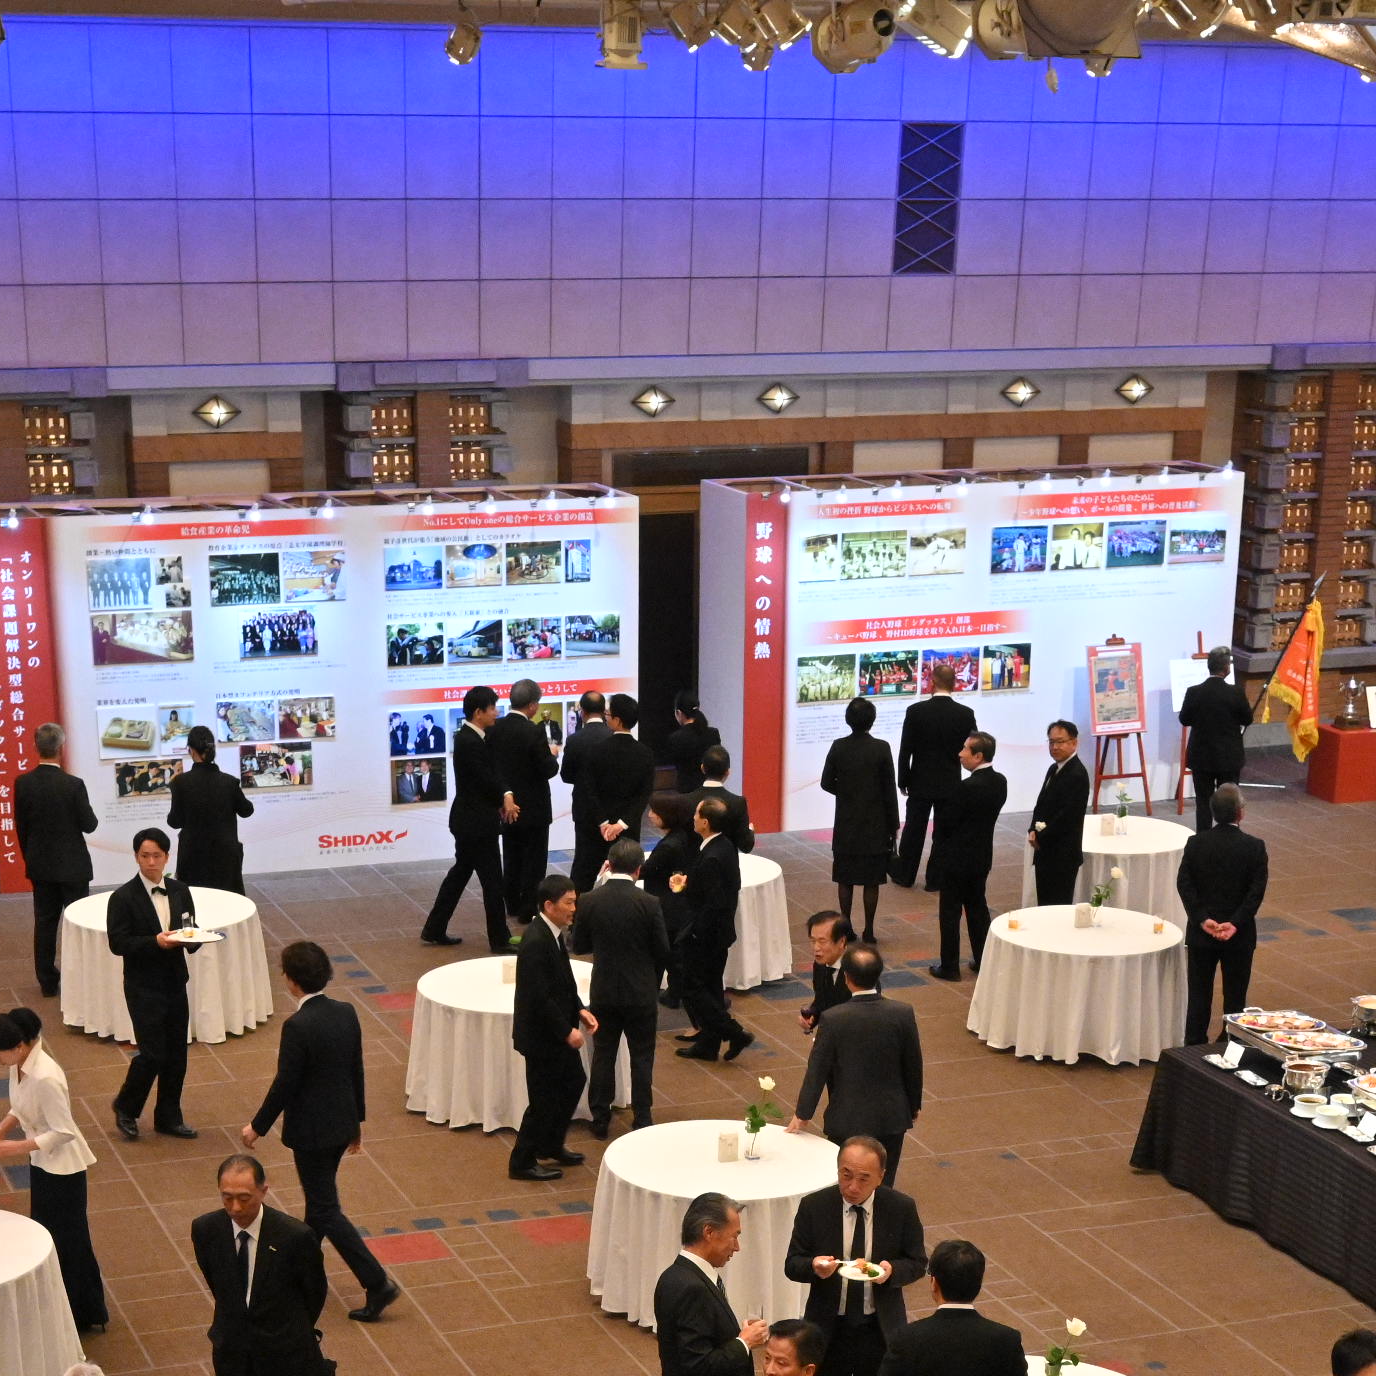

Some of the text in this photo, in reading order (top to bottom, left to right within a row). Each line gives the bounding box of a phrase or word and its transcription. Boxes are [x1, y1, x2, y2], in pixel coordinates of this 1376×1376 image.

[180, 524, 251, 538] 給食産業の革命児
[19, 550, 41, 668] オンリーワンの
[754, 521, 773, 660] 野球への情熱
[0, 554, 28, 772] 「社会課題解決型総合サービ
[318, 829, 394, 849] SHIDAX
